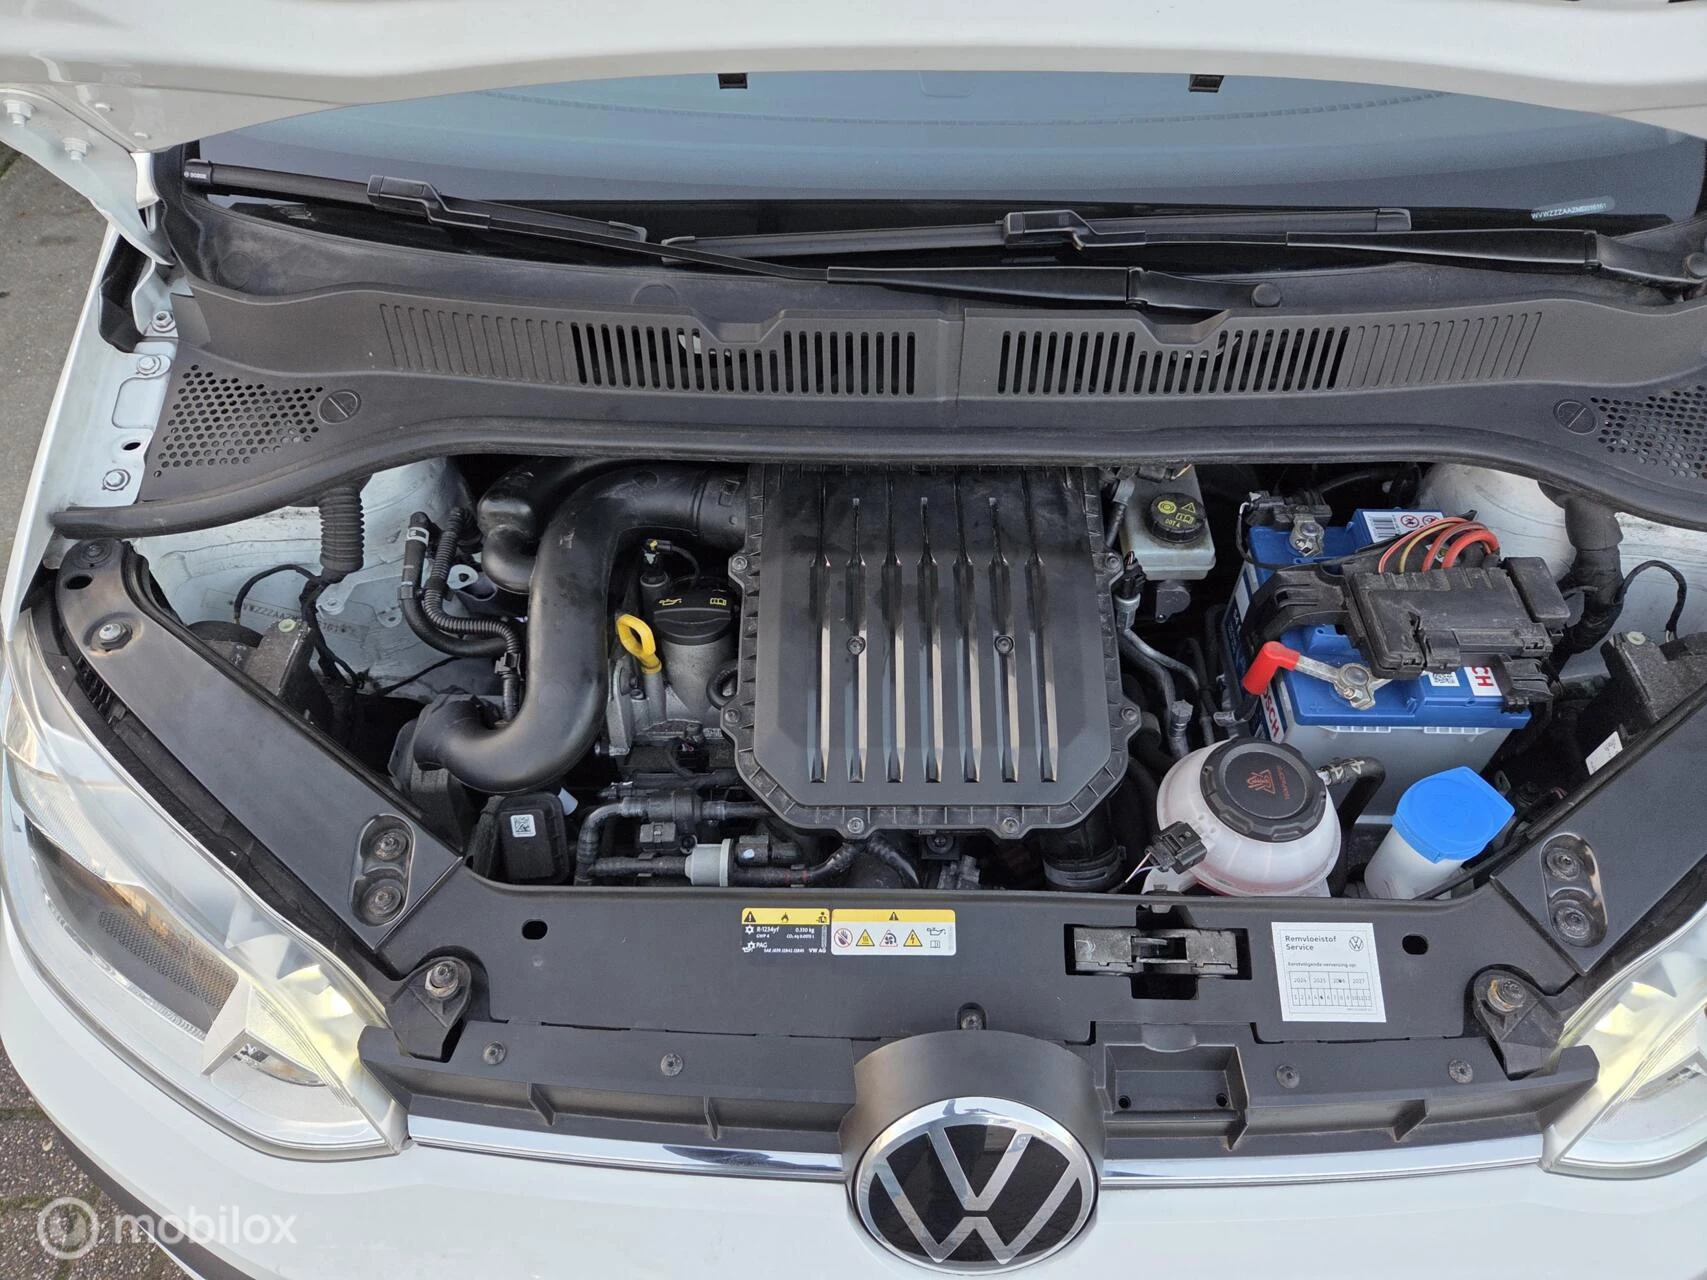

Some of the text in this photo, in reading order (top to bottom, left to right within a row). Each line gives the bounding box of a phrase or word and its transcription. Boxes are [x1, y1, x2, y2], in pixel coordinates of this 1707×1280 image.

[1262, 686, 1280, 737] OSCH
[1285, 935, 1337, 943] Remvloeistof
[870, 1115, 1083, 1264] VW
